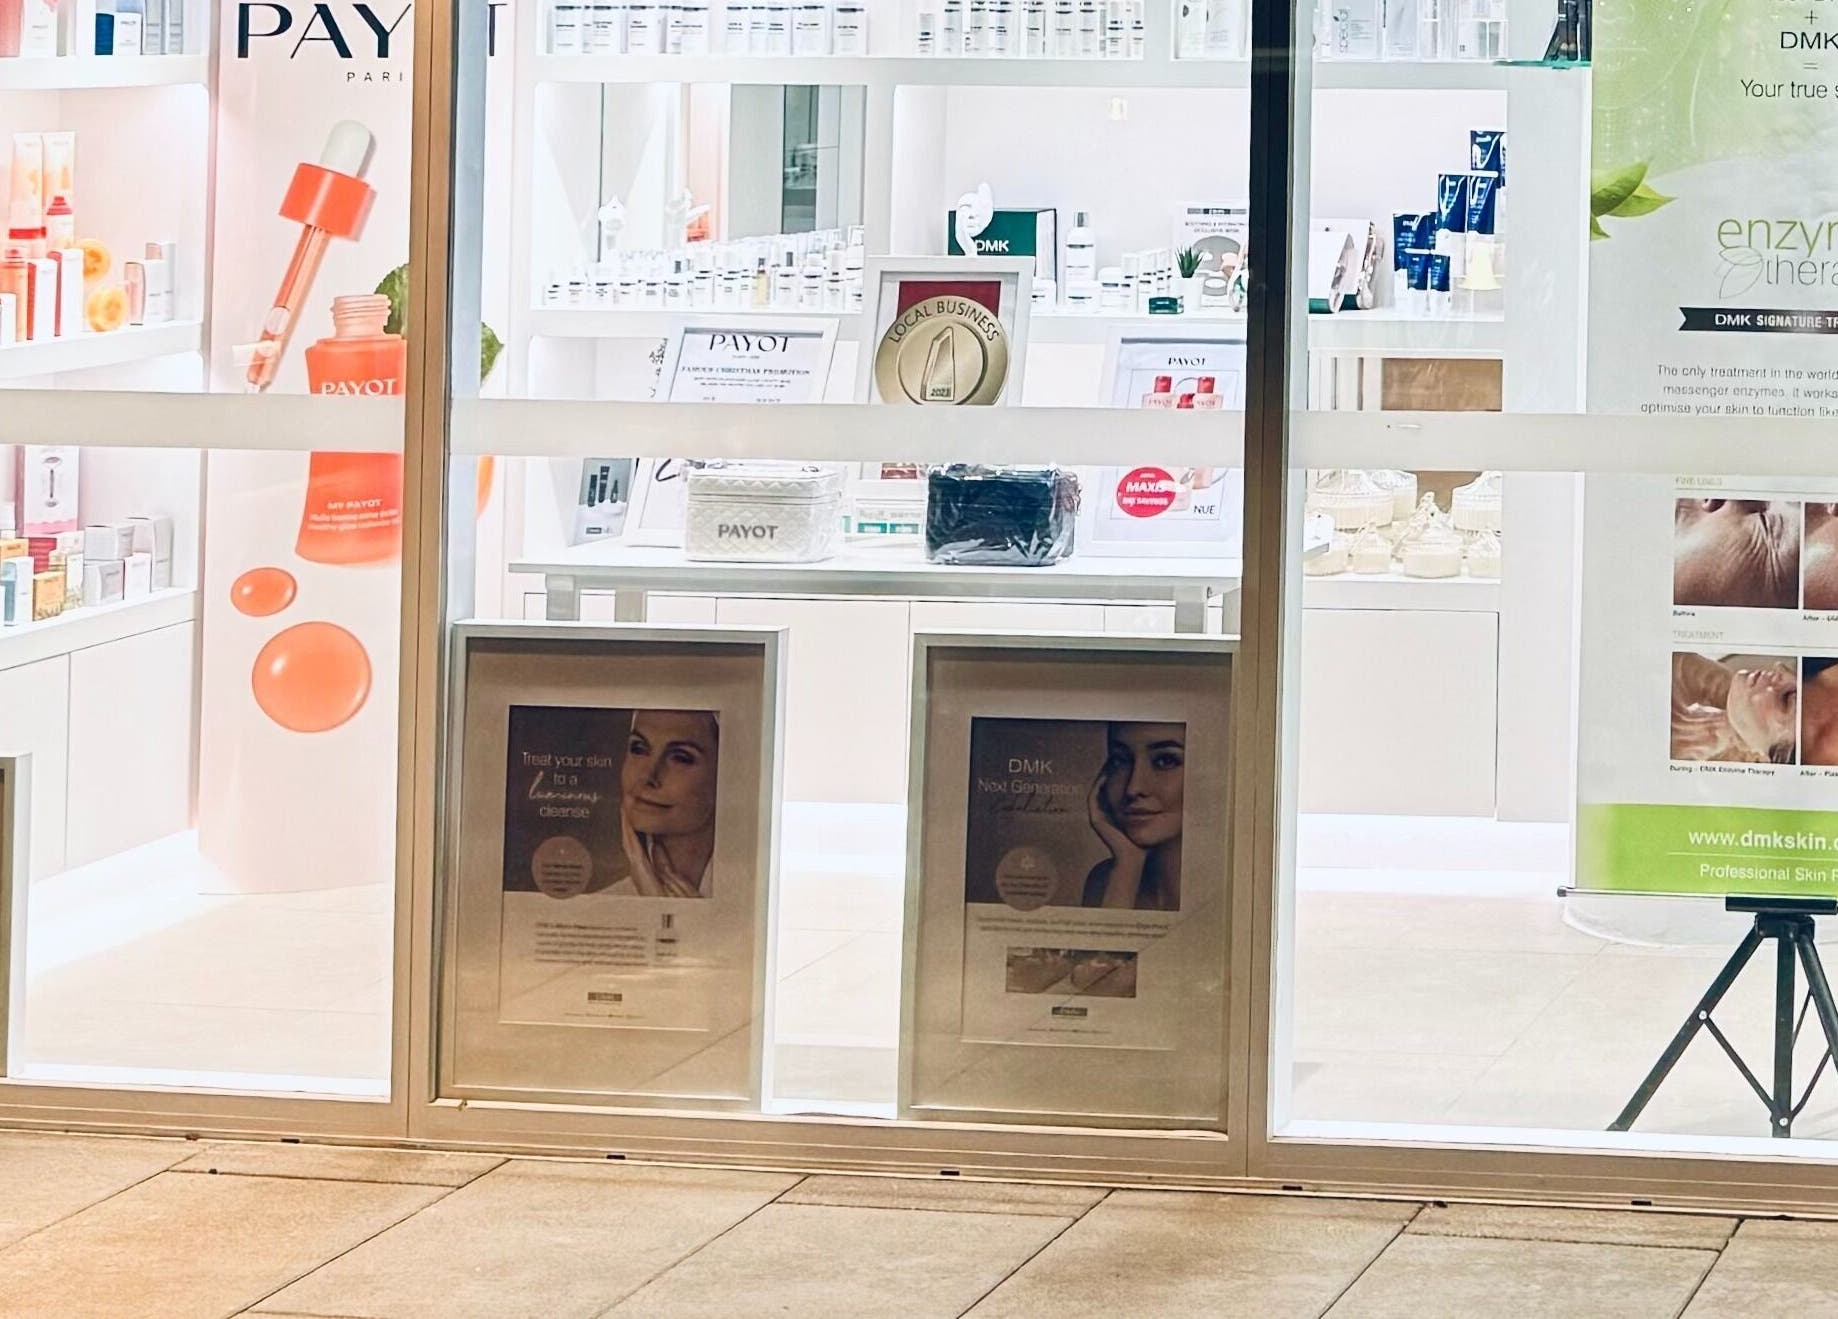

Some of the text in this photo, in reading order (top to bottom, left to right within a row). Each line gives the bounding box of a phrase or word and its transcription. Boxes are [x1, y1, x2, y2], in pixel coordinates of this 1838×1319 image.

[236, 2, 508, 59] PAYT
[346, 71, 404, 83] PARI
[1740, 79, 1785, 98] Your
[1790, 80, 1828, 99] true
[974, 239, 1009, 253] DMK
[888, 300, 1000, 344] LOCAL BUSINESS
[1714, 313, 1751, 327] DMK
[1756, 315, 1822, 329] SIGNATURE
[709, 333, 791, 353] PAYOT
[1168, 357, 1206, 366] PAYOT
[1657, 364, 1678, 377] The
[1682, 365, 1706, 379] only
[1710, 367, 1767, 378] treatment
[1770, 367, 1781, 378] in
[1785, 368, 1803, 380] the
[320, 378, 397, 397] PAYOT
[1663, 384, 1729, 398] messenger
[1792, 387, 1799, 399] it
[1803, 388, 1838, 399] works
[1640, 402, 1691, 415] optimise
[1695, 404, 1721, 416] your
[1725, 403, 1749, 414] skin
[1752, 403, 1764, 415] to
[1768, 404, 1815, 417] function
[1819, 405, 1838, 417] like
[1193, 504, 1216, 515] NUE
[717, 523, 779, 540] PAYOT
[522, 751, 612, 768] Treat your skin
[1008, 758, 1053, 774] DMK
[553, 772, 578, 785] to a
[978, 777, 1007, 792] Next
[539, 803, 590, 818] cleanse
[1699, 863, 1790, 881] Professional
[1794, 867, 1826, 882] Skin
